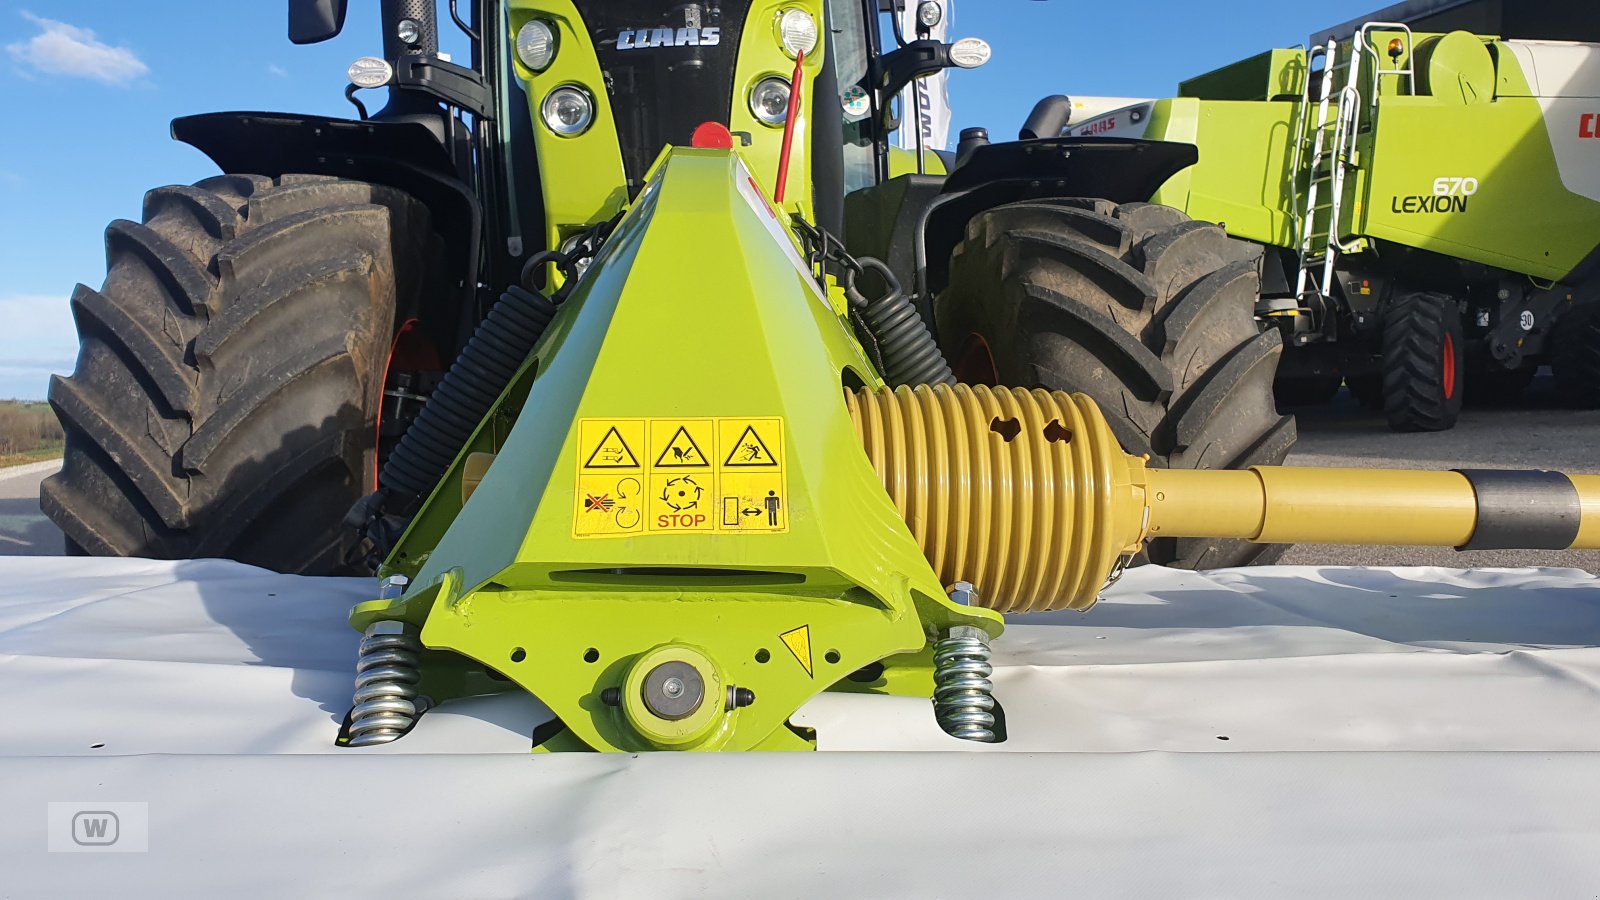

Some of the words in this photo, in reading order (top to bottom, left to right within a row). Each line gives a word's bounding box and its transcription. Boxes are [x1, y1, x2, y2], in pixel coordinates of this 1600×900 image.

[616, 26, 720, 51] CLAAS
[1433, 177, 1478, 196] 670
[1391, 195, 1468, 213] LEXION
[1521, 314, 1532, 327] 30
[657, 514, 706, 528] STOP
